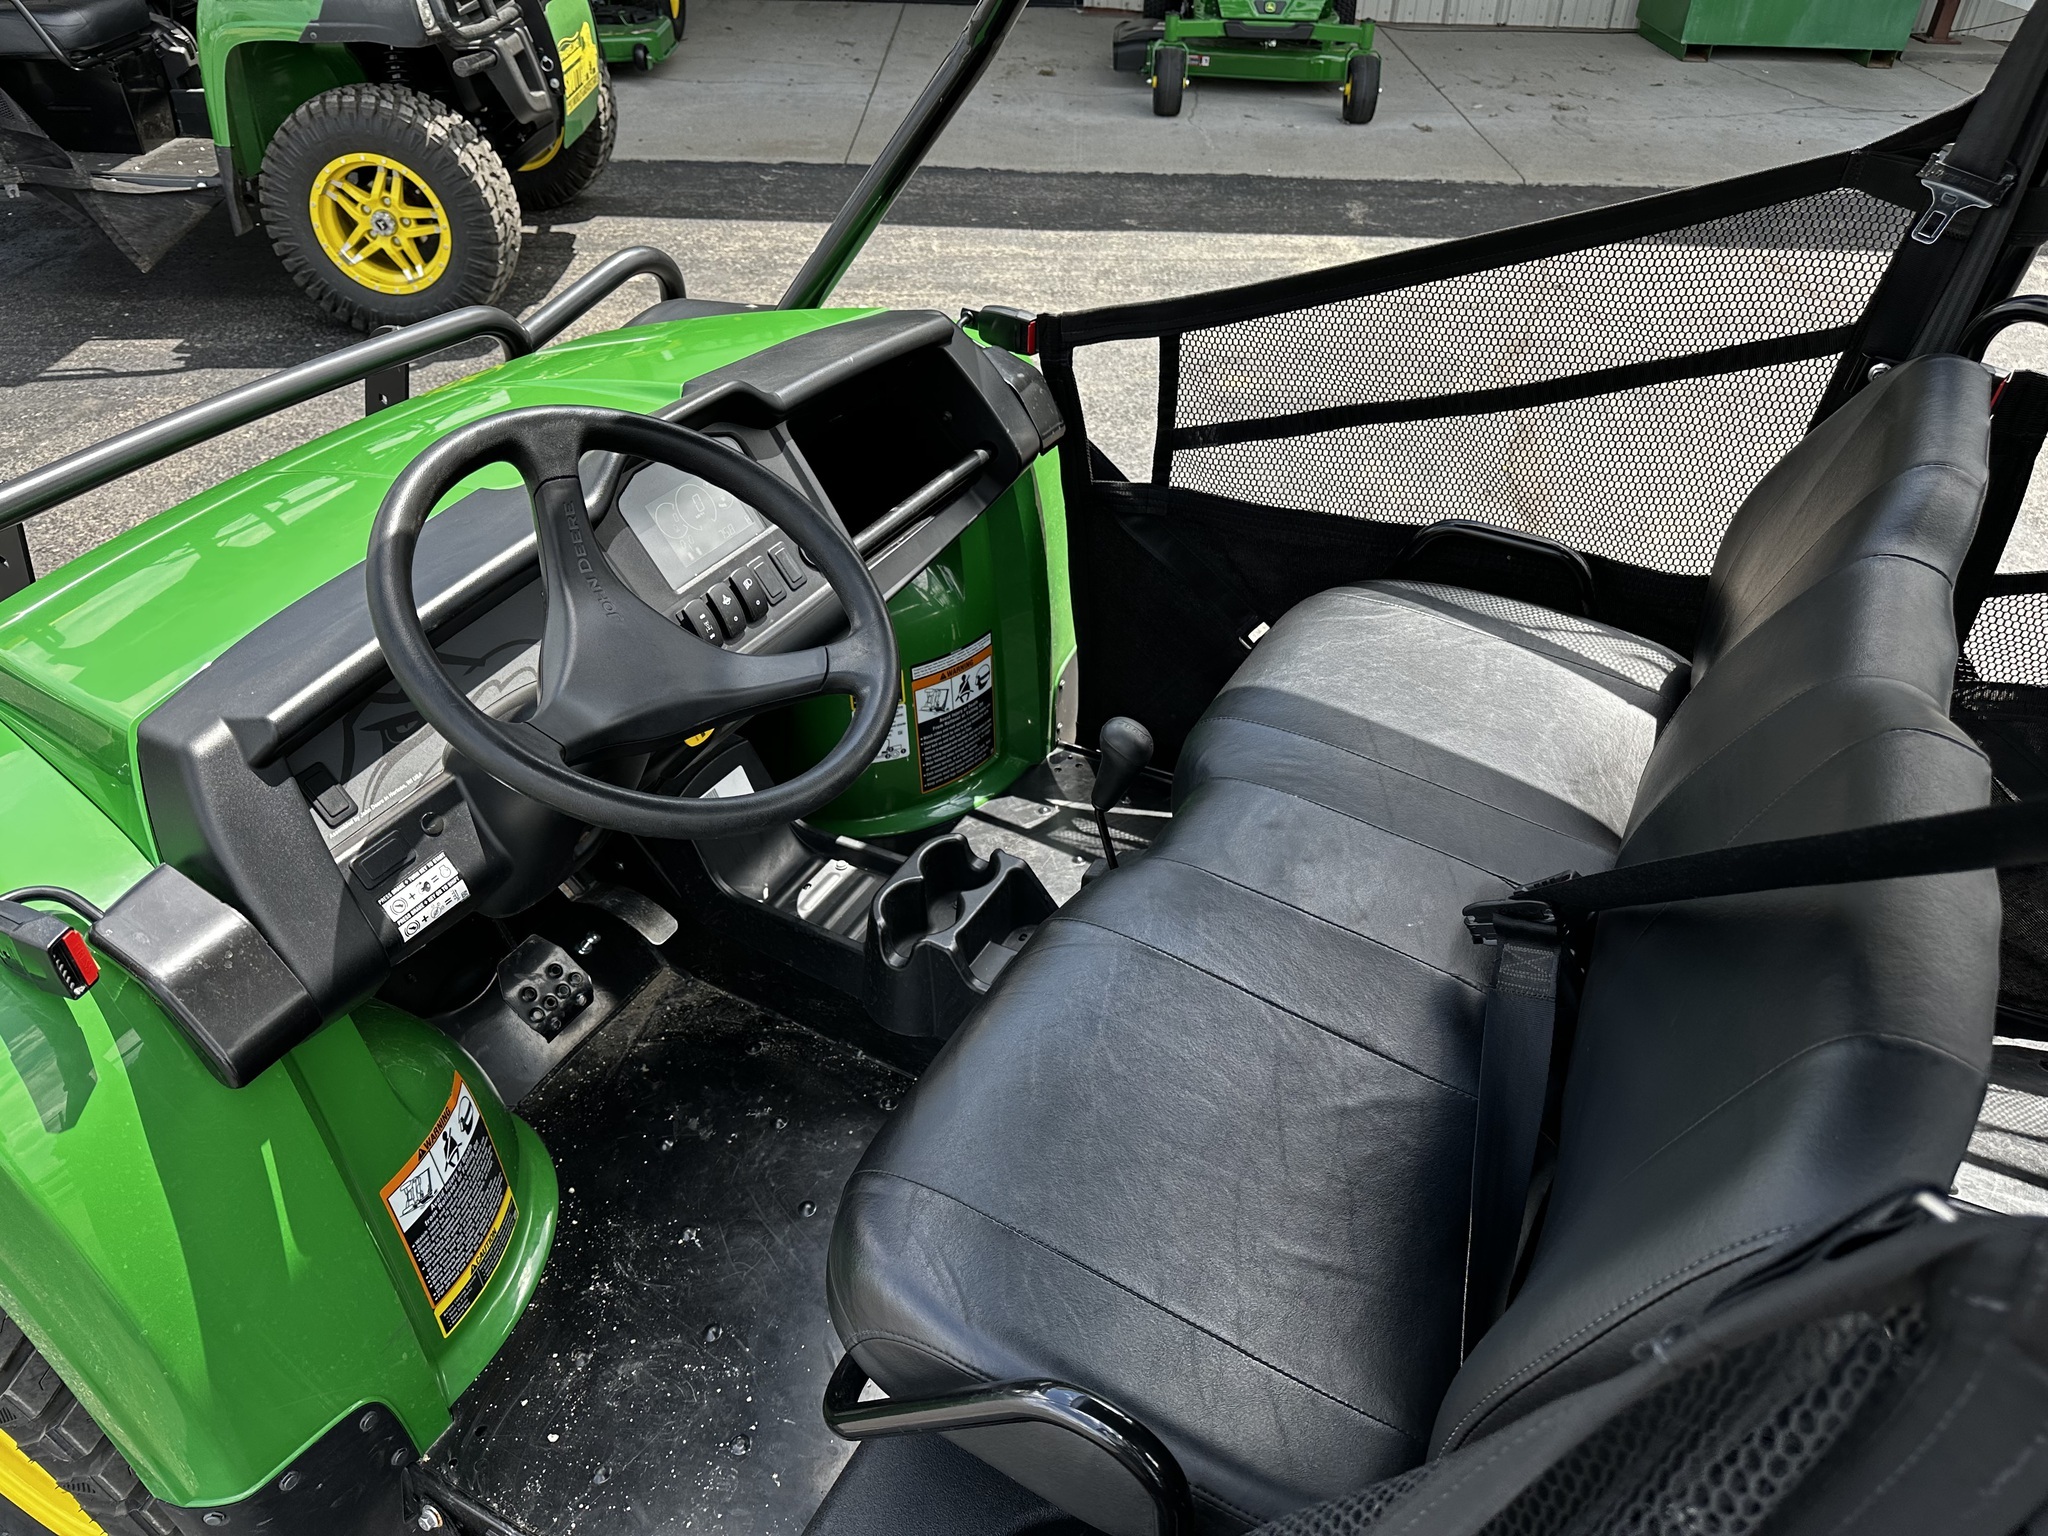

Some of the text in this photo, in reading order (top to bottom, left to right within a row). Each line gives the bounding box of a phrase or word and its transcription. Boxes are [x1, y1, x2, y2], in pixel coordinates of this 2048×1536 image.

[564, 501, 624, 622] JOHN DEERE
[948, 659, 973, 678] WARNING
[329, 819, 355, 839] Assembled
[359, 807, 372, 818] John
[371, 799, 385, 810] Deere
[412, 772, 423, 781] USA
[378, 892, 392, 905] PRESS
[391, 882, 406, 895] BRAKE
[418, 865, 428, 874] KEY
[426, 860, 434, 868] TO
[432, 852, 446, 864] START
[410, 902, 425, 916] BRAKE
[427, 893, 437, 903] KEY
[435, 889, 443, 897] ON
[442, 884, 449, 892] TO
[424, 1106, 452, 1151] WARNING
[425, 1209, 437, 1226] from
[438, 1181, 458, 1210] Rollover
[430, 1190, 445, 1211] Avoid
[445, 1171, 459, 1192] Injury
[476, 1227, 498, 1266] CAUTION
